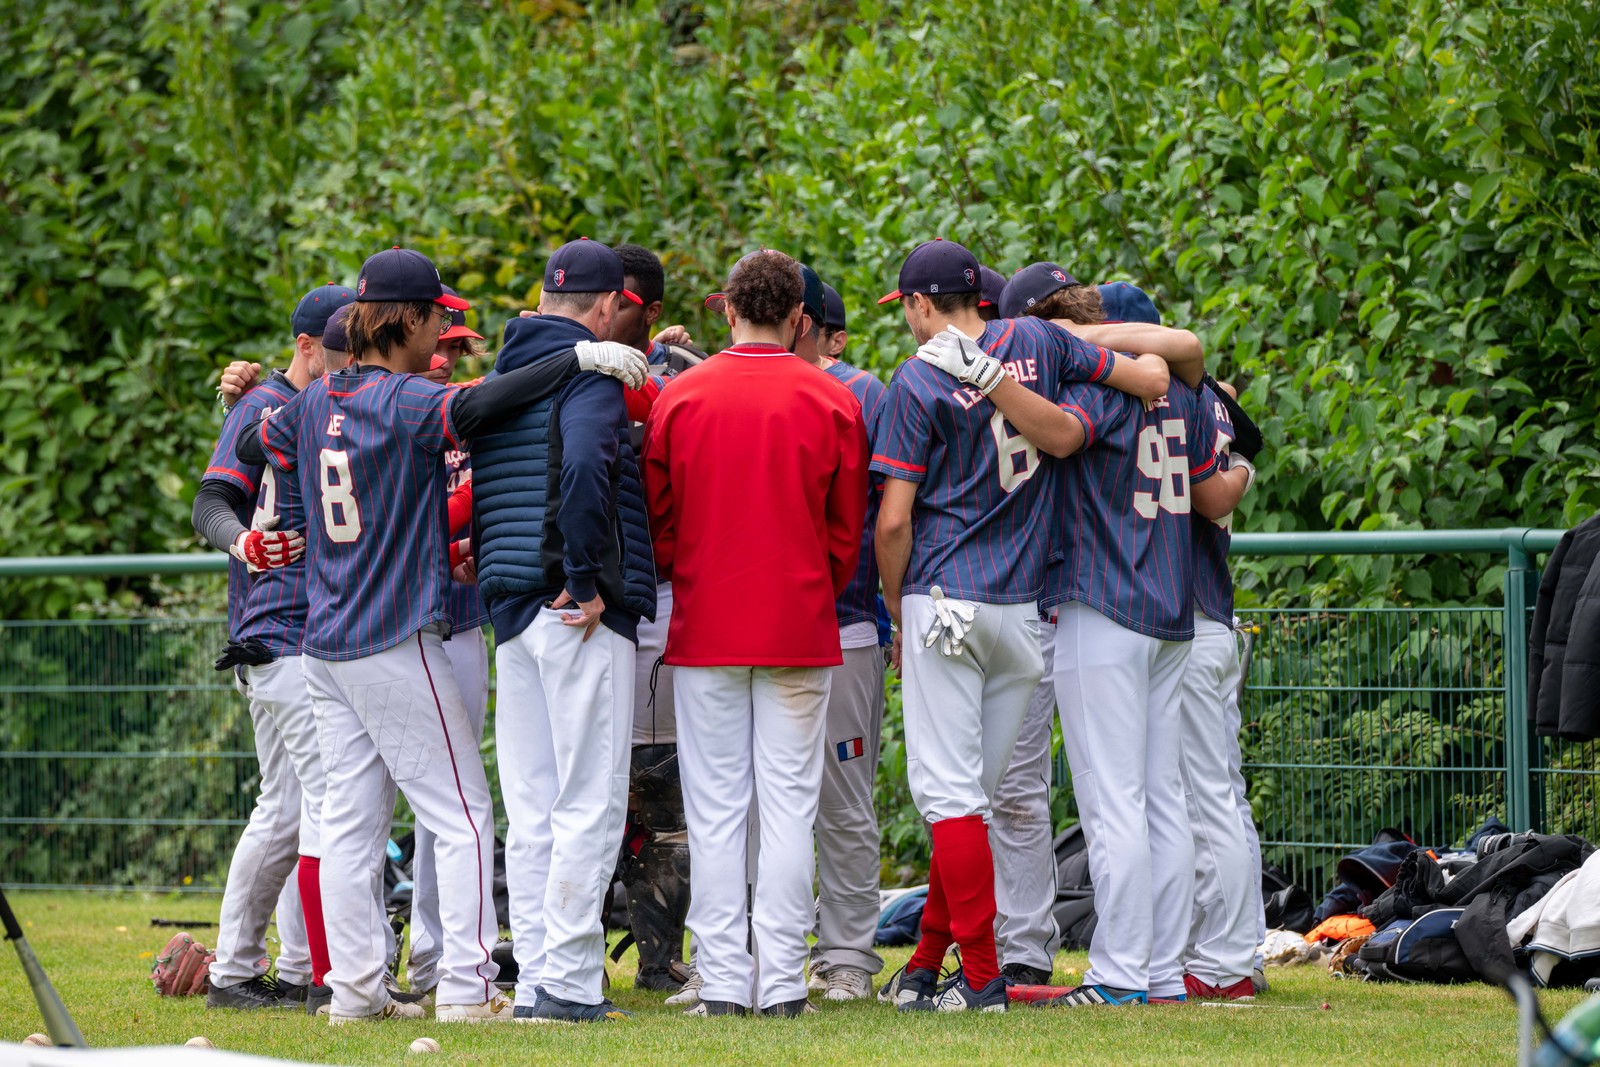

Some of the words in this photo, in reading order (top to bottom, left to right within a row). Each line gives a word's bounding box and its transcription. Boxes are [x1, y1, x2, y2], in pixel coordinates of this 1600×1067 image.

[952, 358, 1038, 410] LEBLE
[974, 360, 991, 384] FORCE
[990, 407, 1042, 493] 6
[1133, 418, 1192, 519] 96
[320, 448, 362, 543] 8
